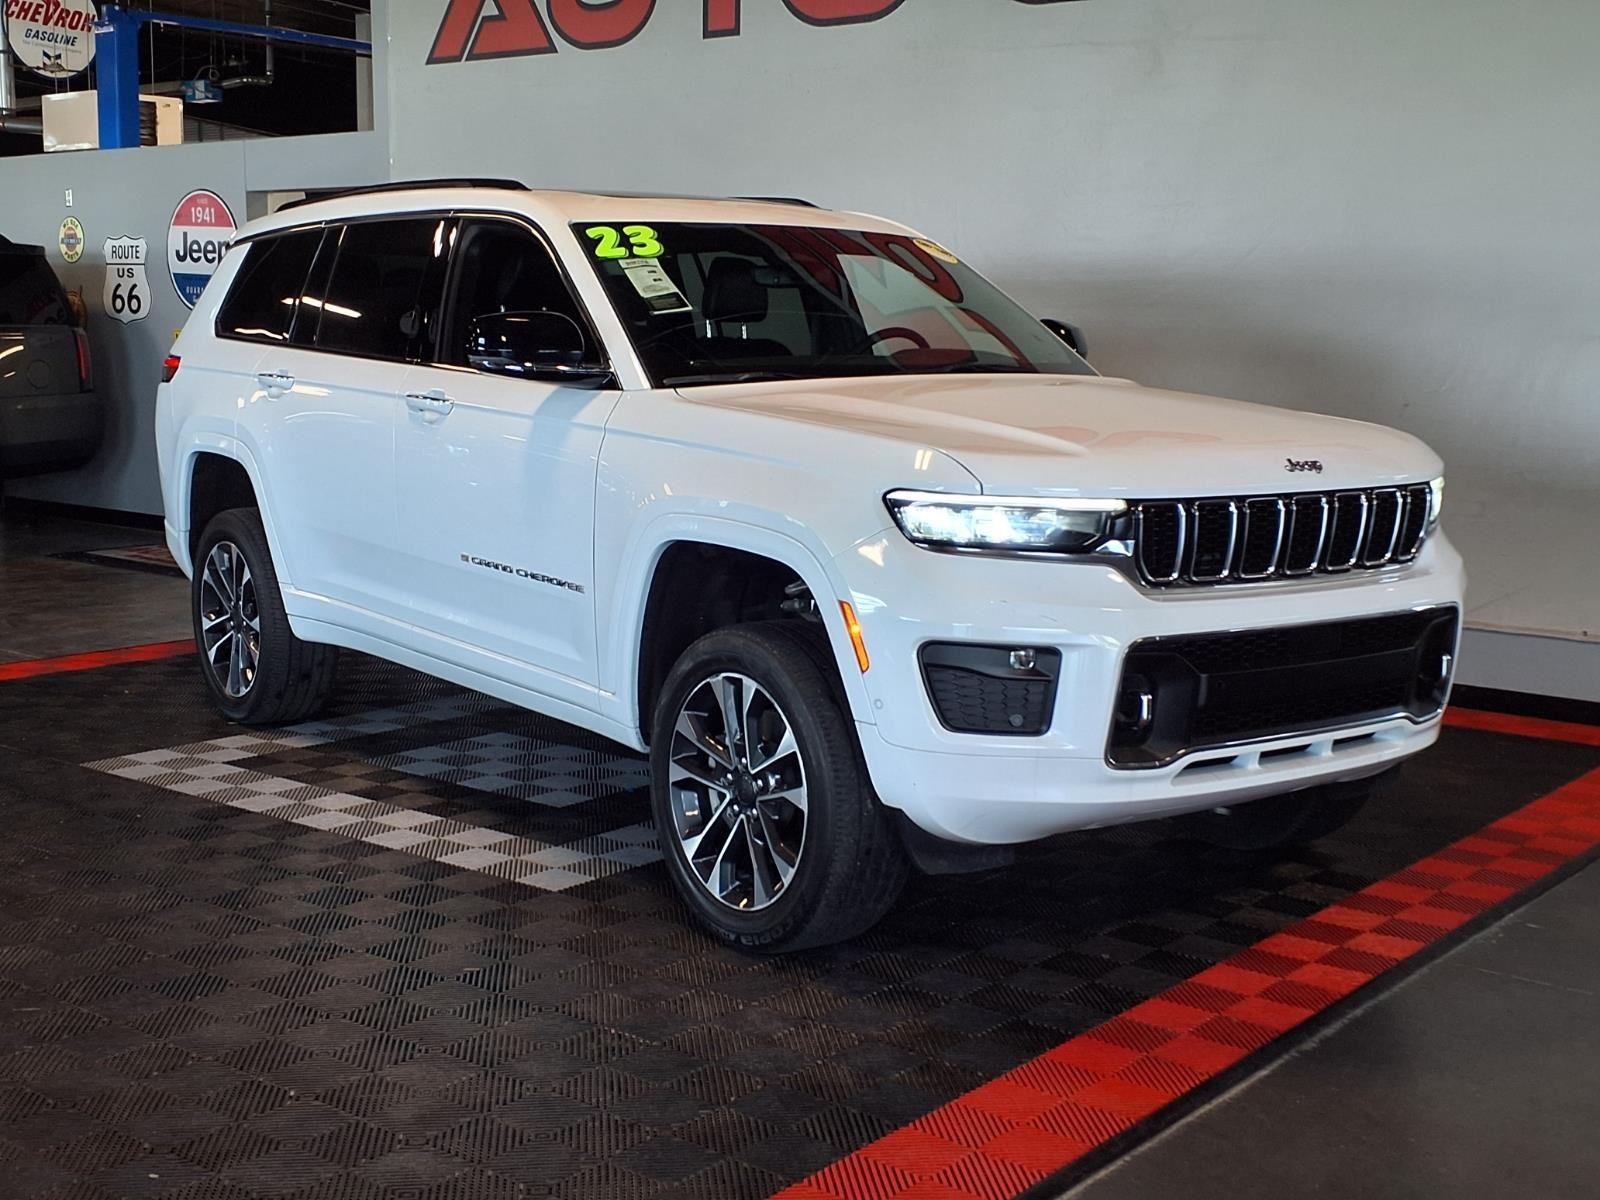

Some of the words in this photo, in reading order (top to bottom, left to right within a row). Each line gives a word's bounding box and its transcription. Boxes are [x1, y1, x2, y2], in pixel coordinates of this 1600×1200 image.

[5, 0, 96, 33] CHEVRON
[24, 28, 78, 47] GASOLINE
[190, 206, 216, 224] 1941
[585, 225, 665, 259] 23
[111, 245, 140, 260] ROUTE
[117, 267, 135, 278] US
[111, 283, 142, 314] 66
[1284, 458, 1323, 474] Jeep
[471, 557, 514, 574] GRAND
[515, 568, 585, 594] CHEROKEE
